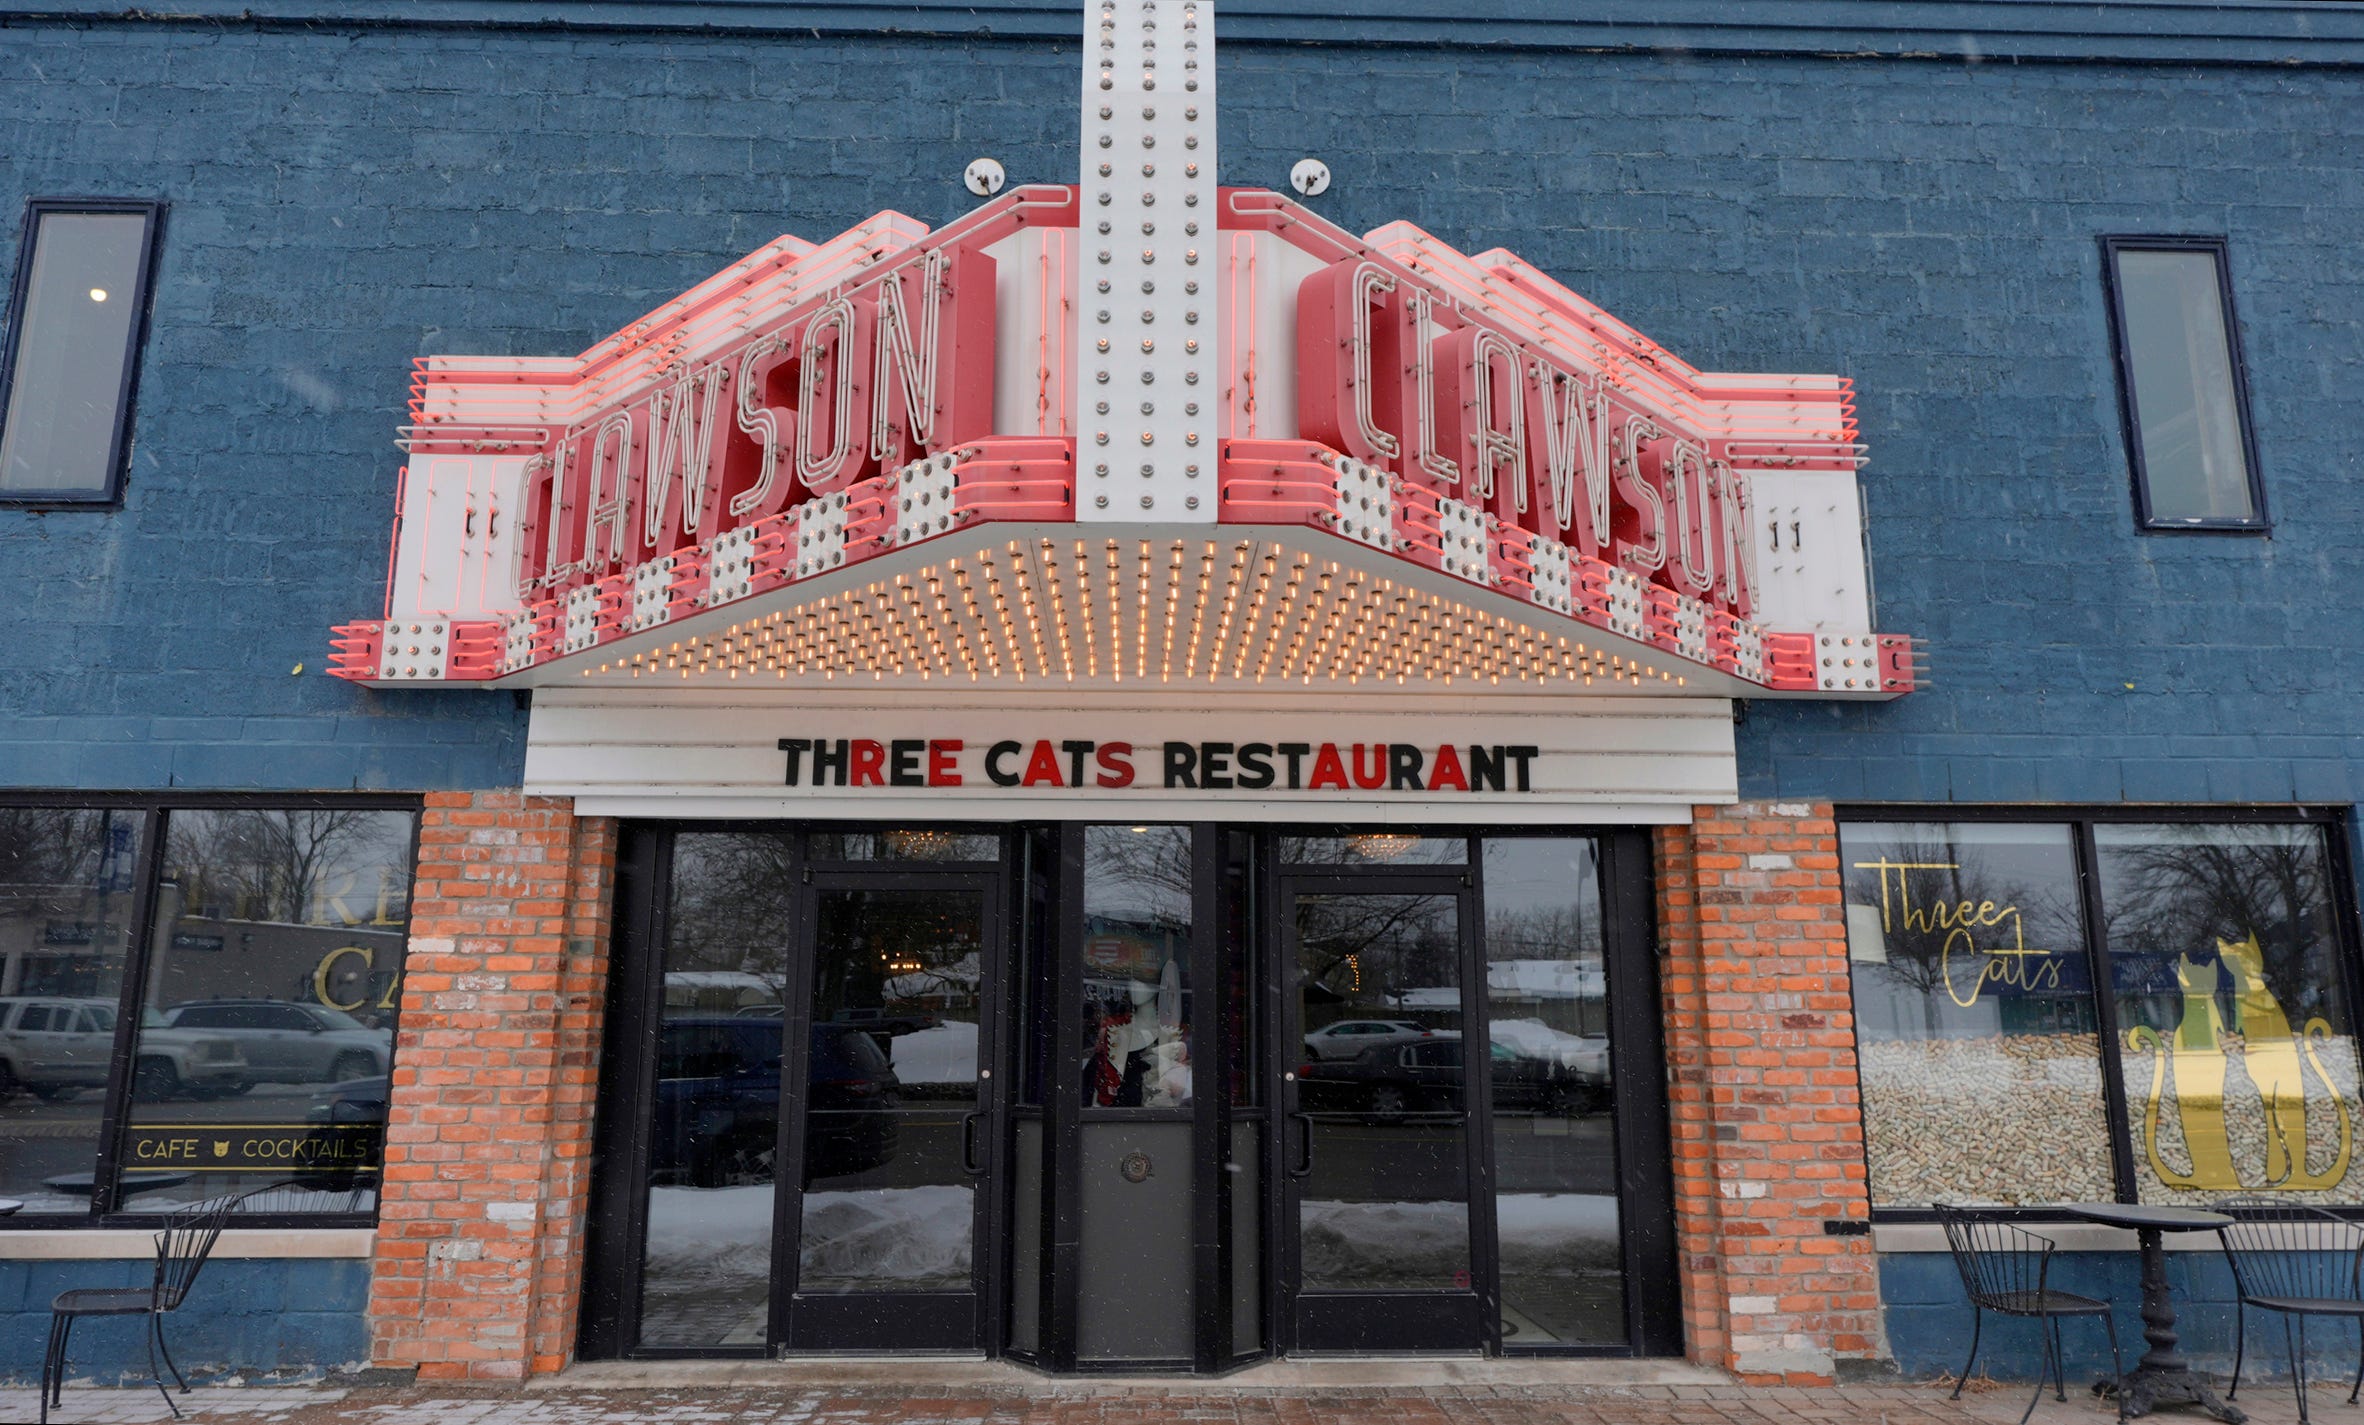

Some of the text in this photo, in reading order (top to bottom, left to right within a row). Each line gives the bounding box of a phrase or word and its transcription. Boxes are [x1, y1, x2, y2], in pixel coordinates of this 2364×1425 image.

[509, 246, 960, 605] CLAWSON
[1340, 259, 1762, 618] CLAWSON
[778, 738, 1540, 791] THREE CATS RESTAURANT
[1853, 856, 2017, 934] Three
[1942, 914, 2064, 1008] Cats
[137, 1139, 368, 1159] CAFE COCKTAILS
